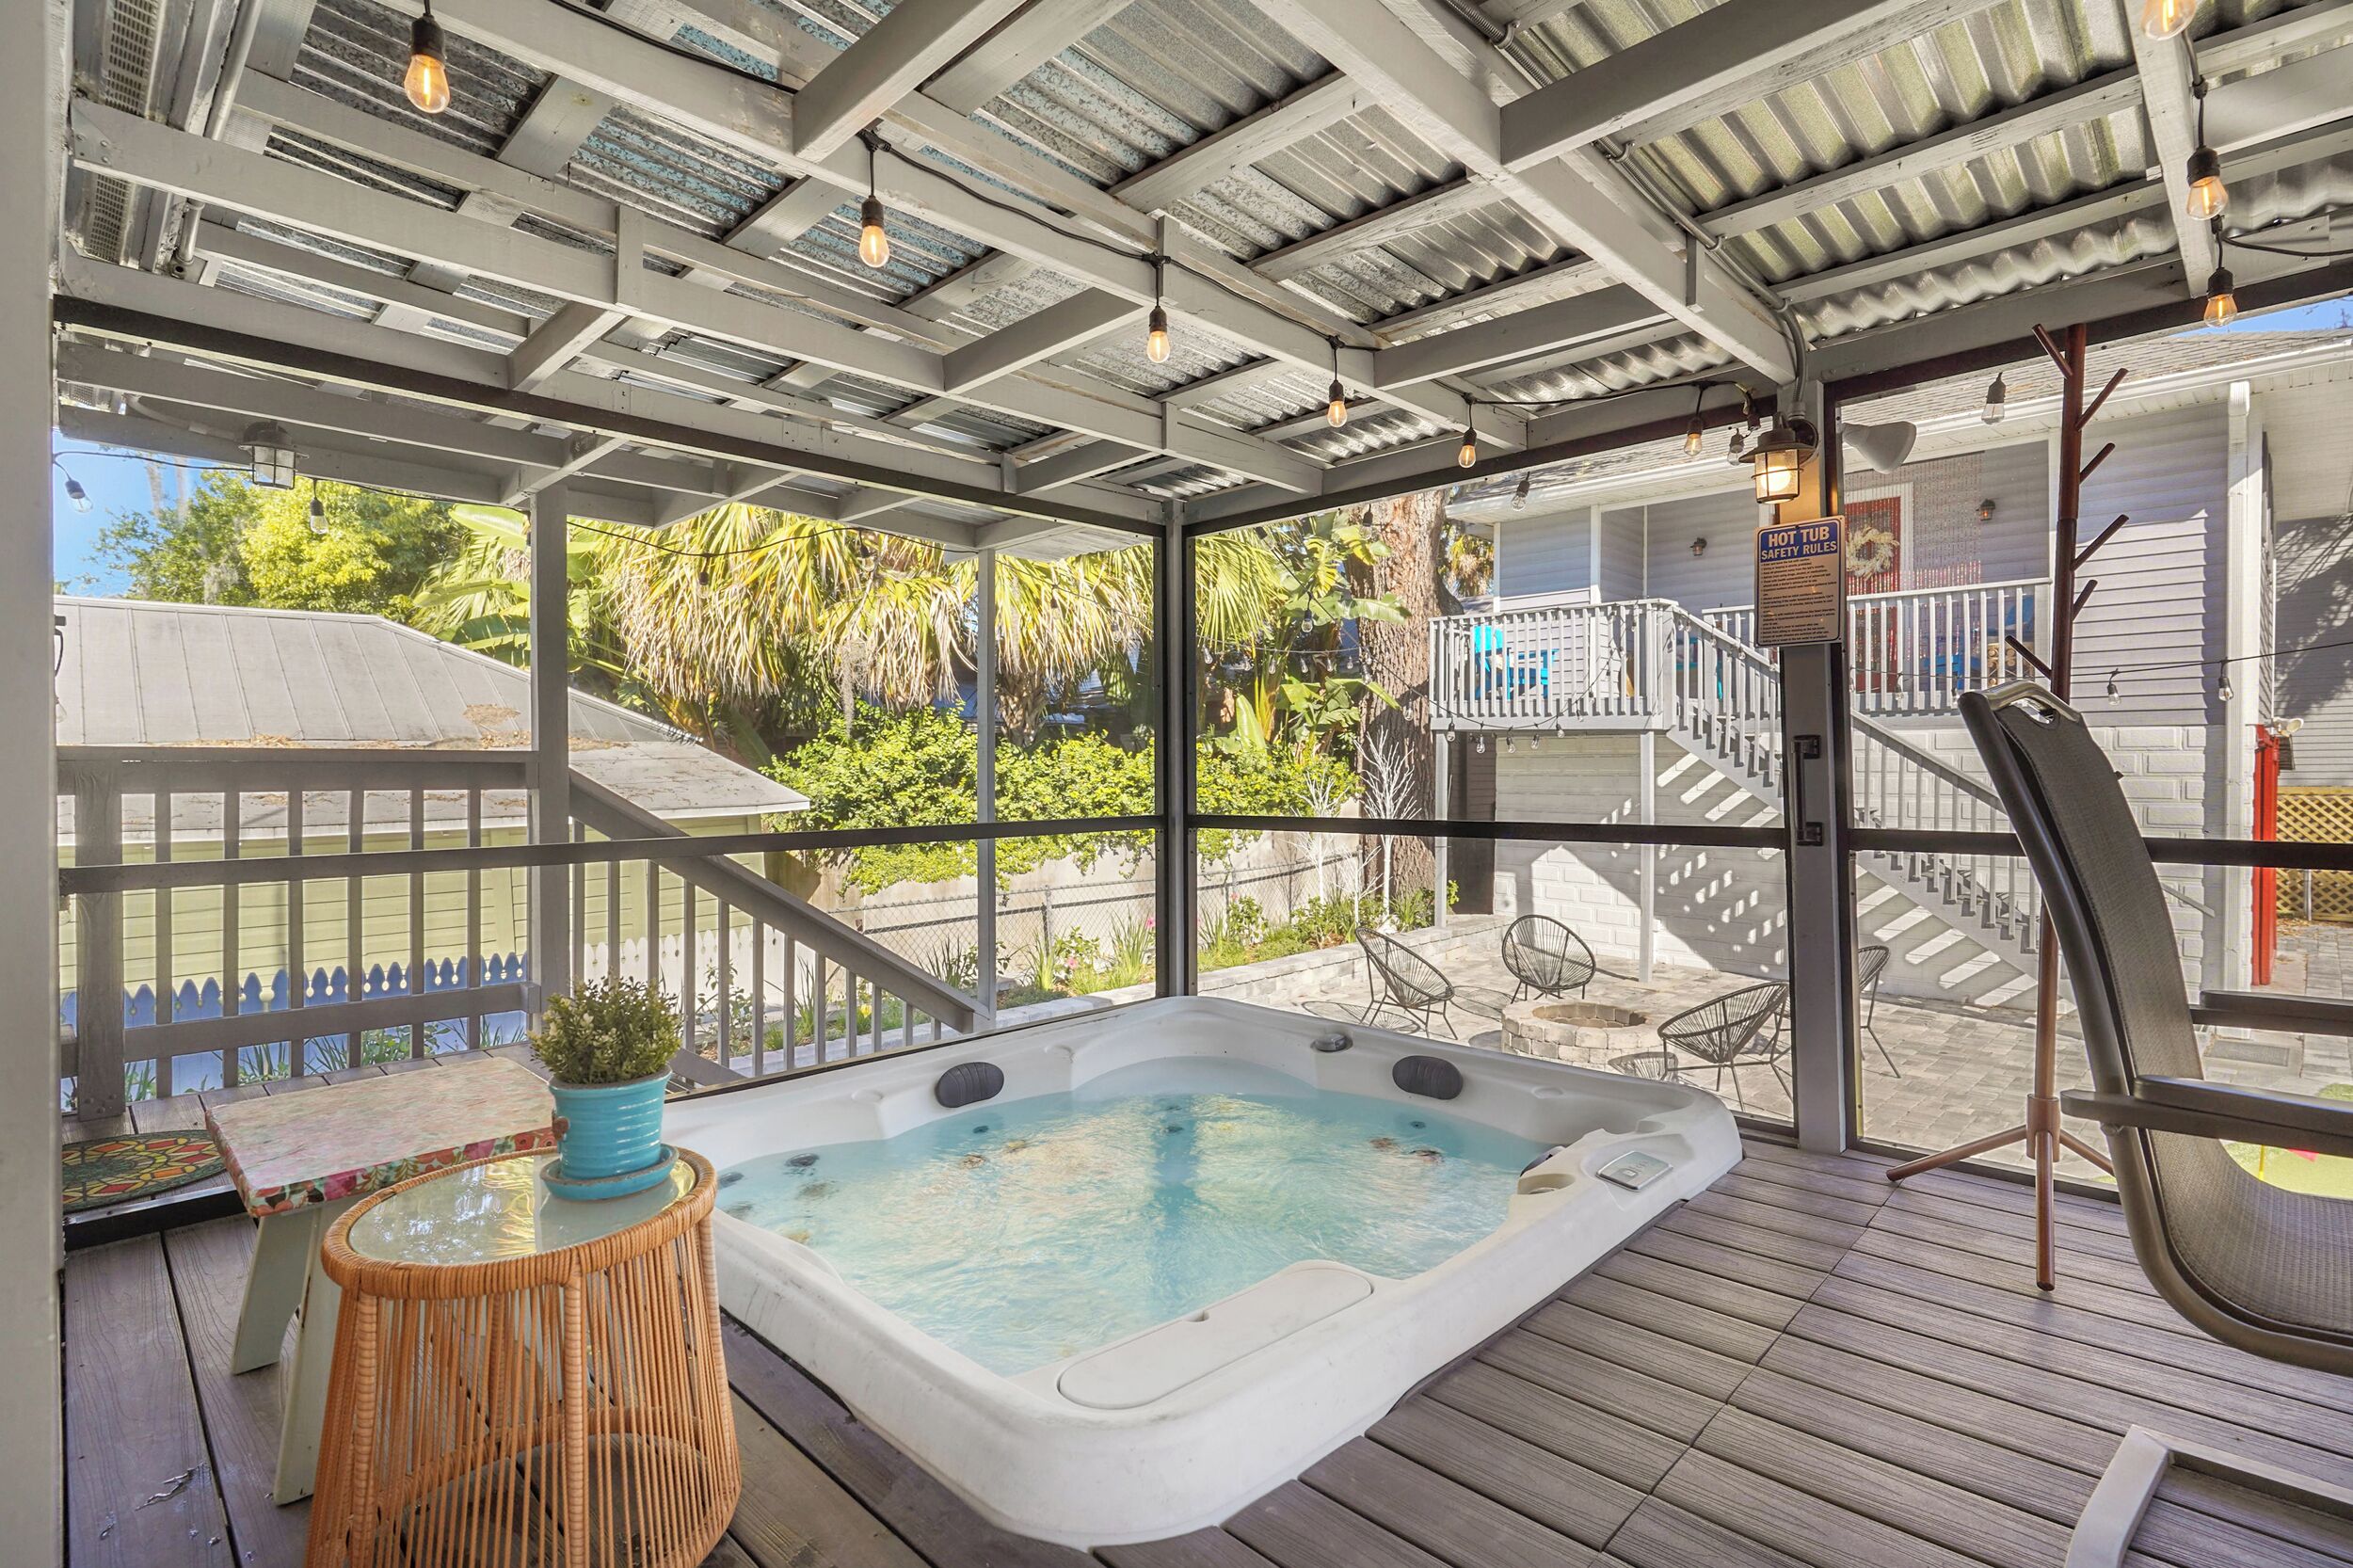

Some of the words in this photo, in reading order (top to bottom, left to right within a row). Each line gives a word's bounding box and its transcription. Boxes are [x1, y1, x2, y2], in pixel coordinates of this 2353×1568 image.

[1769, 531, 1797, 548] HOT
[1801, 526, 1830, 543] TUB
[1761, 546, 1800, 560] SAFETY
[1803, 541, 1837, 554] RULES
